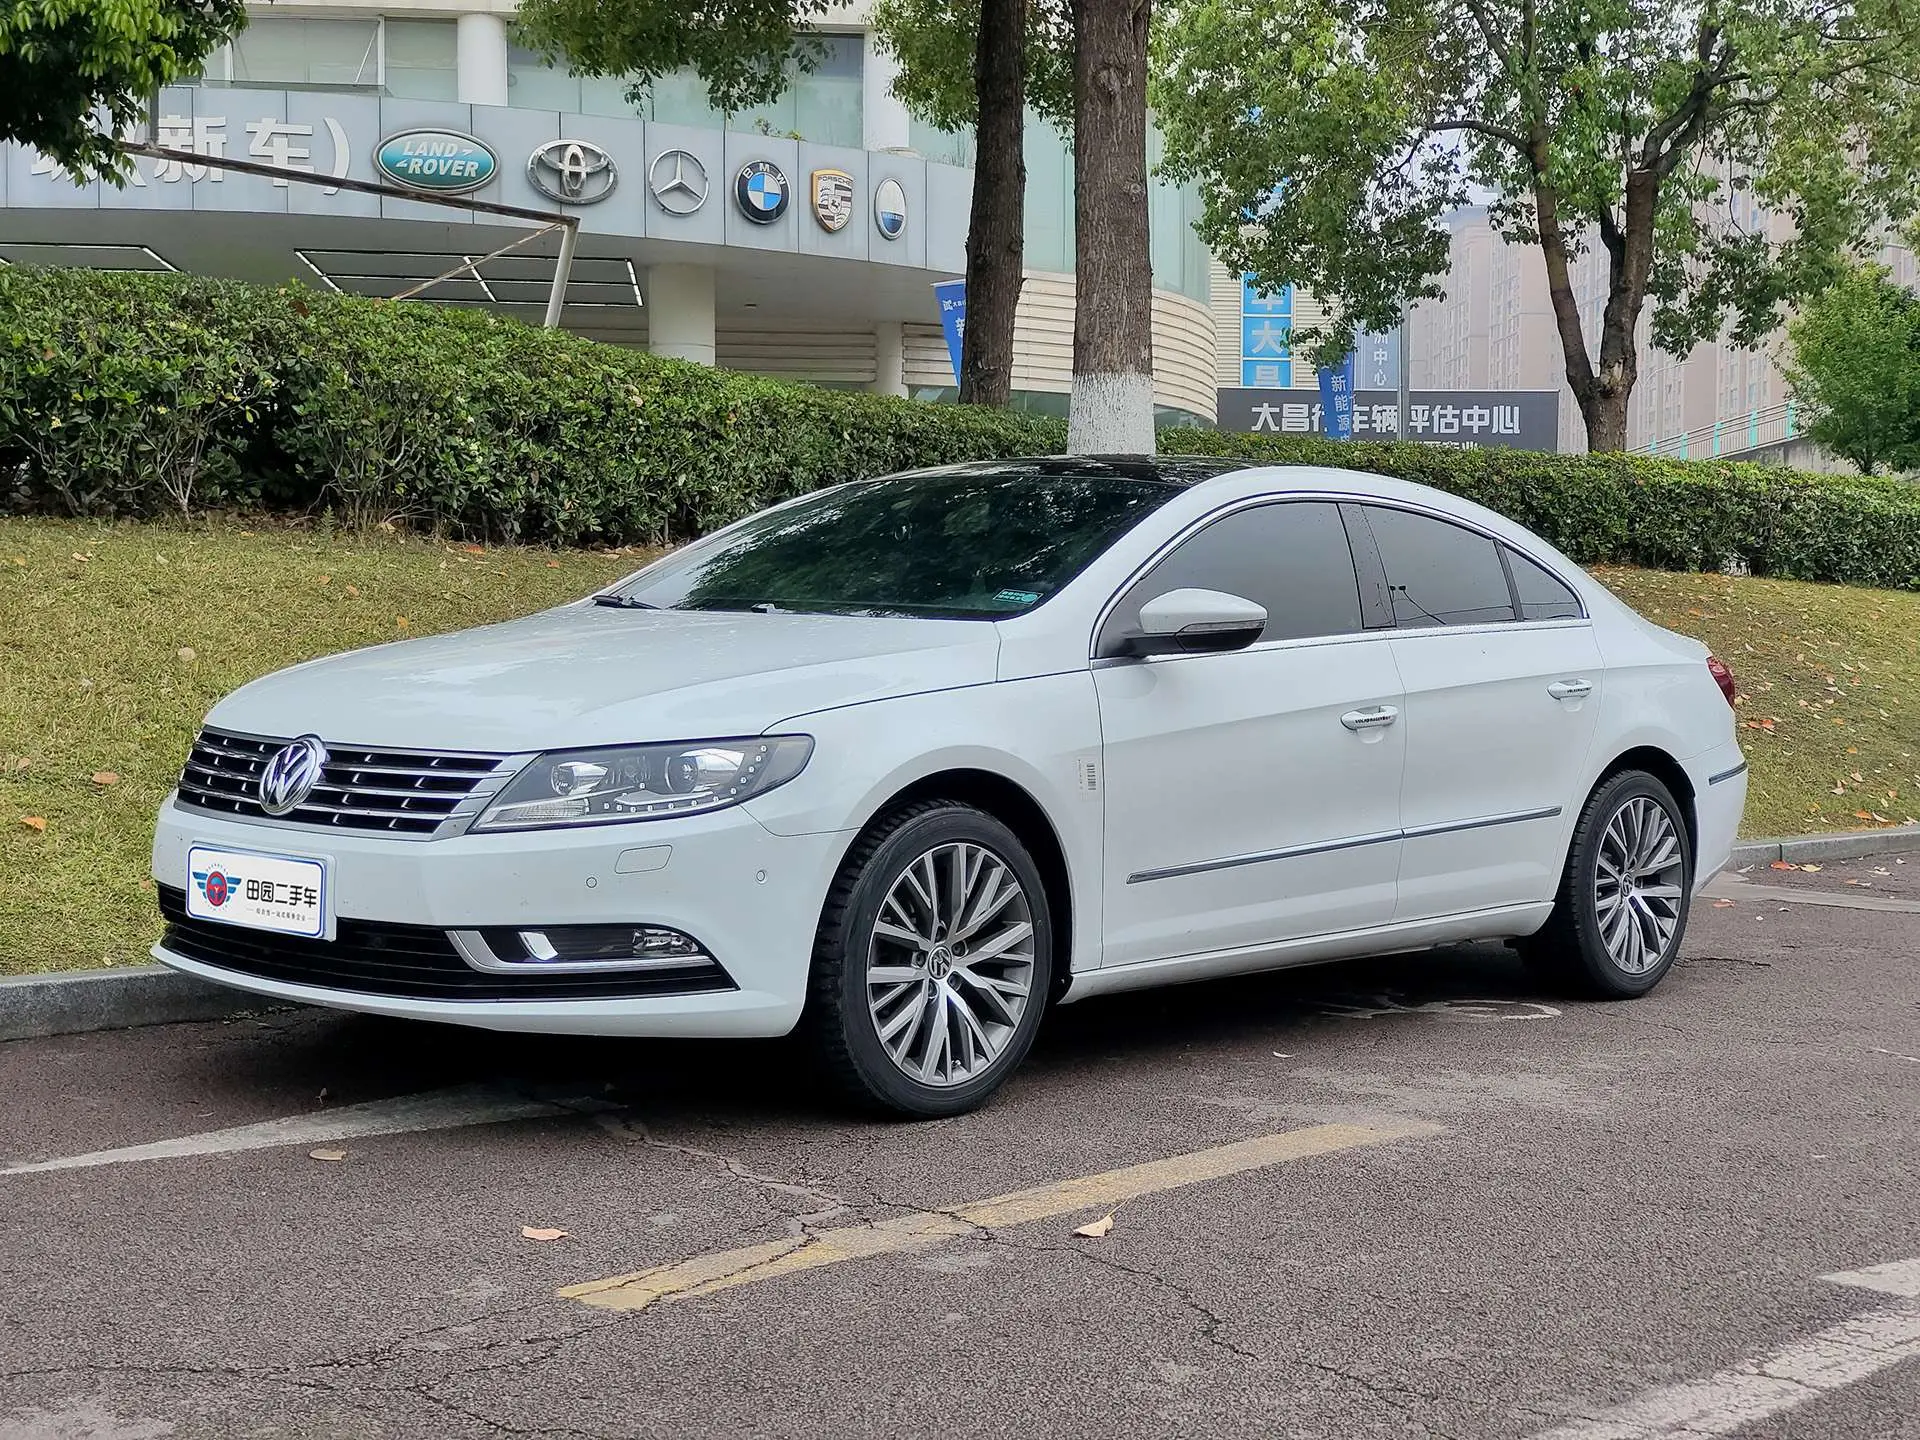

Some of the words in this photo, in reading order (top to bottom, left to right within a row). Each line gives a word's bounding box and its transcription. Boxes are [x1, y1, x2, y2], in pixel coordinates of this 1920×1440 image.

[402, 141, 458, 157] LAND
[407, 157, 479, 178] ROVER
[743, 162, 786, 186] BMW
[246, 879, 318, 908] 田园二手车
